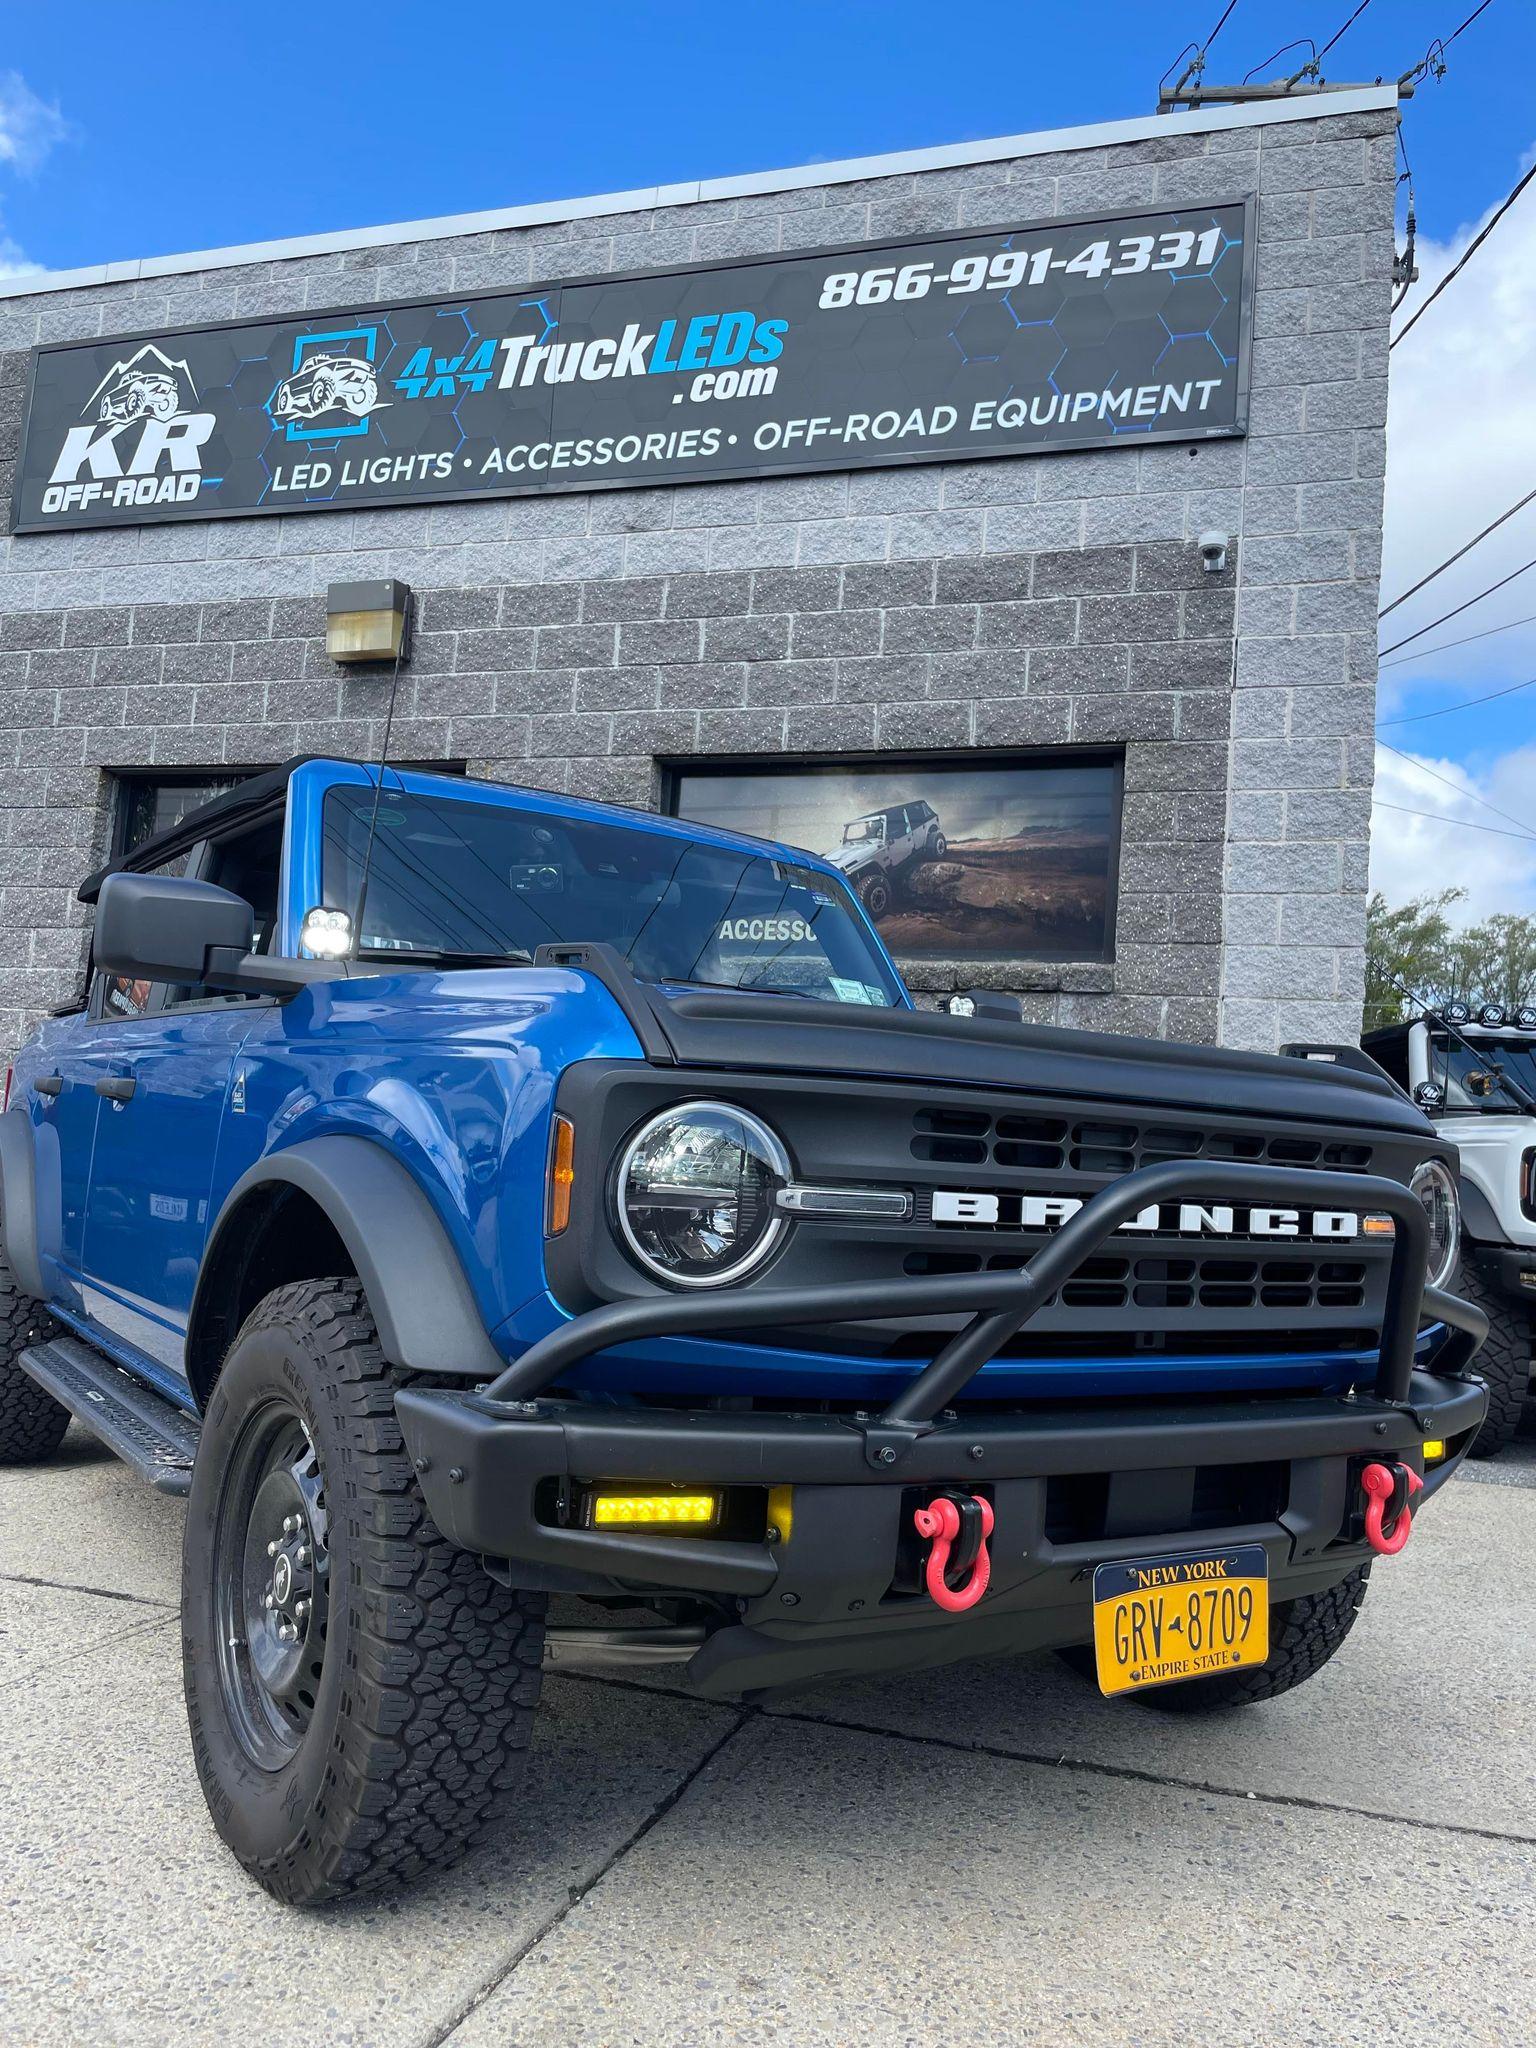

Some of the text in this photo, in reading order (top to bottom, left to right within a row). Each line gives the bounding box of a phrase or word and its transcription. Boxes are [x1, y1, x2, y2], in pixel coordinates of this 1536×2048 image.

[817, 226, 1222, 310] 866-991-4331
[672, 366, 779, 405] .com
[48, 413, 216, 484] KR
[271, 379, 1222, 492] LED LIGHTS ACCESSORIES OFF-ROAD EQUIPMENT
[41, 474, 201, 514] OFF-ROAD
[1138, 1559, 1227, 1588] NEW YORK
[1114, 1586, 1253, 1665] GRV 8709
[1141, 1650, 1229, 1680] EMPIRE STATE
